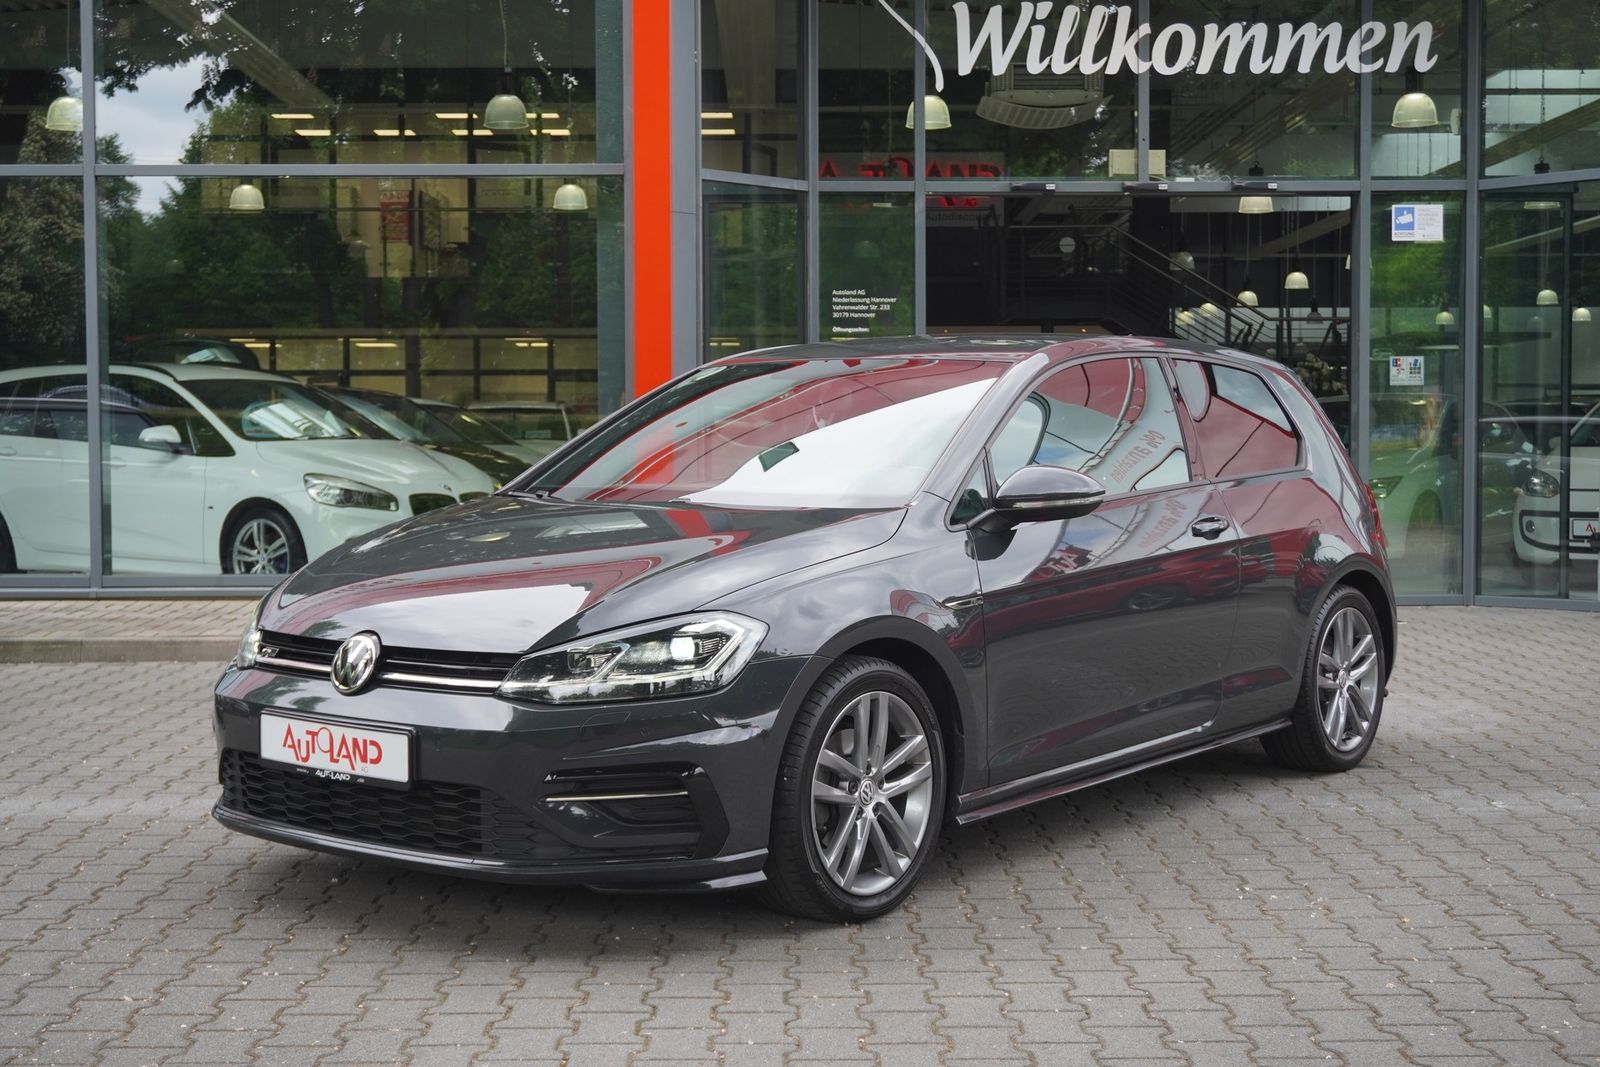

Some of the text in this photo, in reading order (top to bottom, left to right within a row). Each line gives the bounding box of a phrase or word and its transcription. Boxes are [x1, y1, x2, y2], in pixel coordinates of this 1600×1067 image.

[952, 1, 1438, 76] Willkommen
[832, 296, 870, 304] Niederlassung
[282, 722, 383, 771] AUTOLAND
